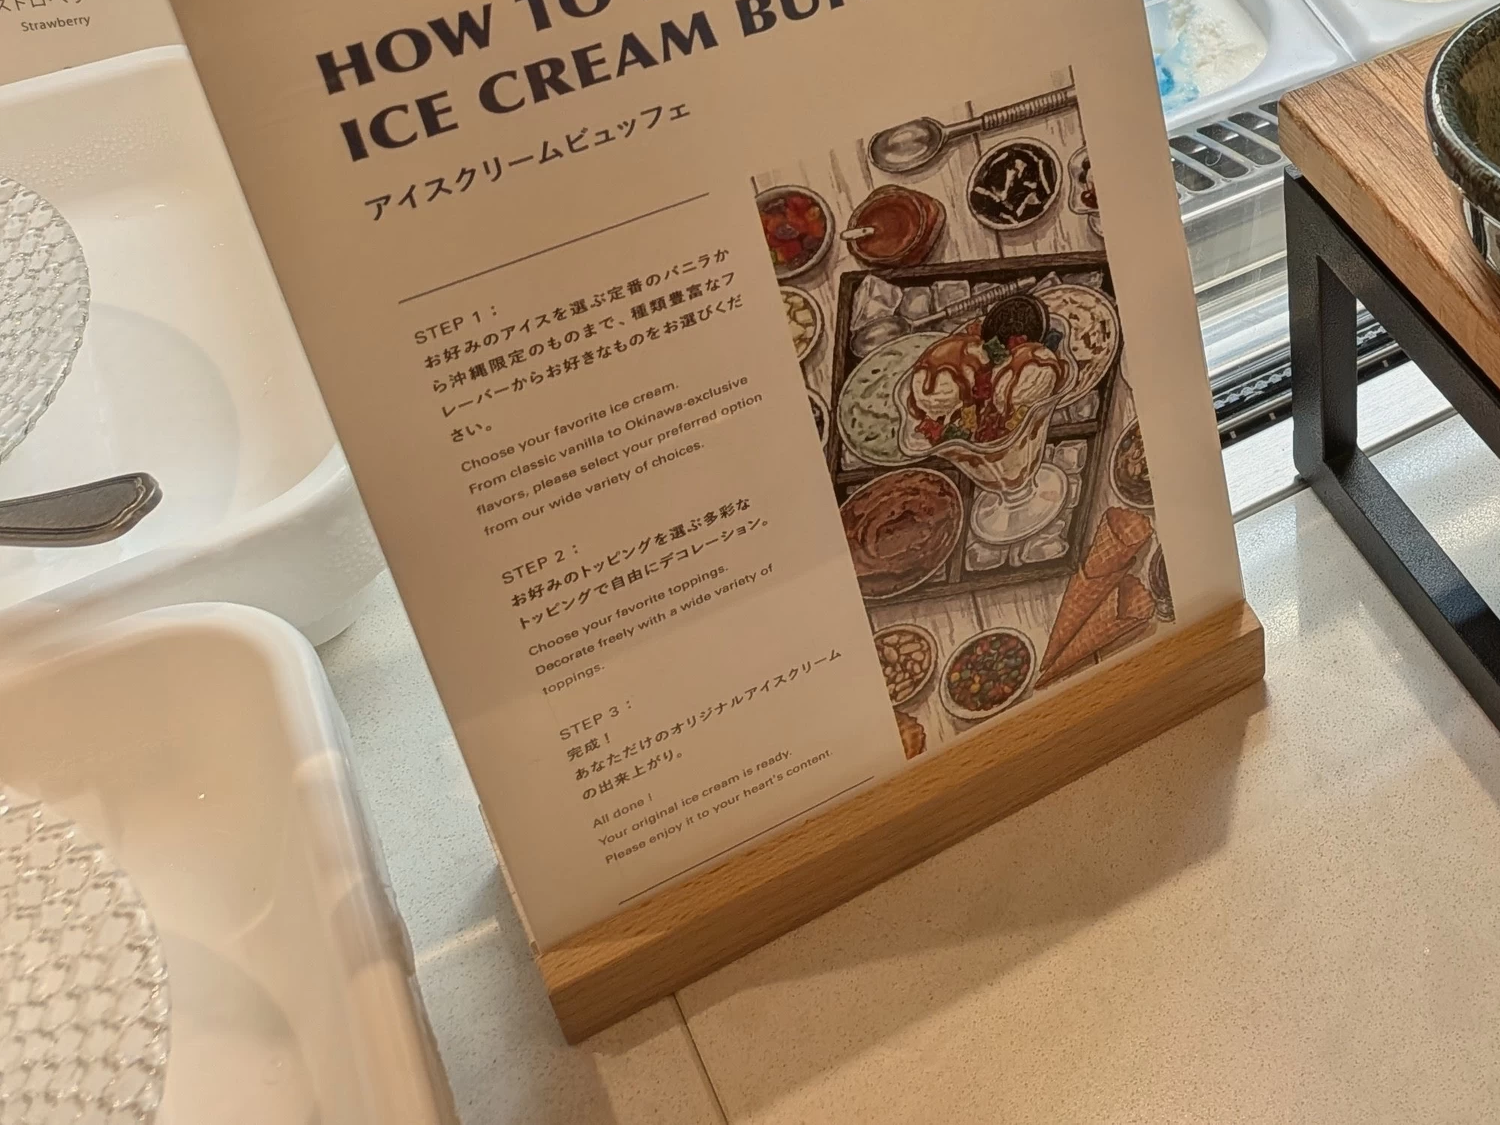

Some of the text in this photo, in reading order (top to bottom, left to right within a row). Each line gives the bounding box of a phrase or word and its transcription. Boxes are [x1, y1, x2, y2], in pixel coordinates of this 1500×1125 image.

[20, 16, 91, 32] Strawberry
[314, 1, 493, 97] HOW
[338, 89, 460, 164] ICE
[477, 9, 720, 116] CREAM
[363, 102, 692, 223] アイスクリームビュッフェ
[414, 316, 464, 345] STEP
[461, 382, 679, 473] Choose your favorite ice cream.
[468, 376, 748, 495] From classic vanilla to Okinawa-exclusive
[476, 394, 763, 516] flavors, please select your preferred option
[483, 442, 705, 536] from our wide variety of choices.
[501, 556, 548, 585] STEP
[528, 565, 729, 656] Choose your favorite toppings.
[535, 562, 773, 676] Decorate freely with a wide variety of
[542, 664, 605, 696] toppings.
[559, 712, 603, 741] STEP
[593, 813, 610, 829] All
[597, 750, 793, 846] Your original ice cream is ready.
[605, 748, 834, 865] Please enjoy it to your heart's content.
